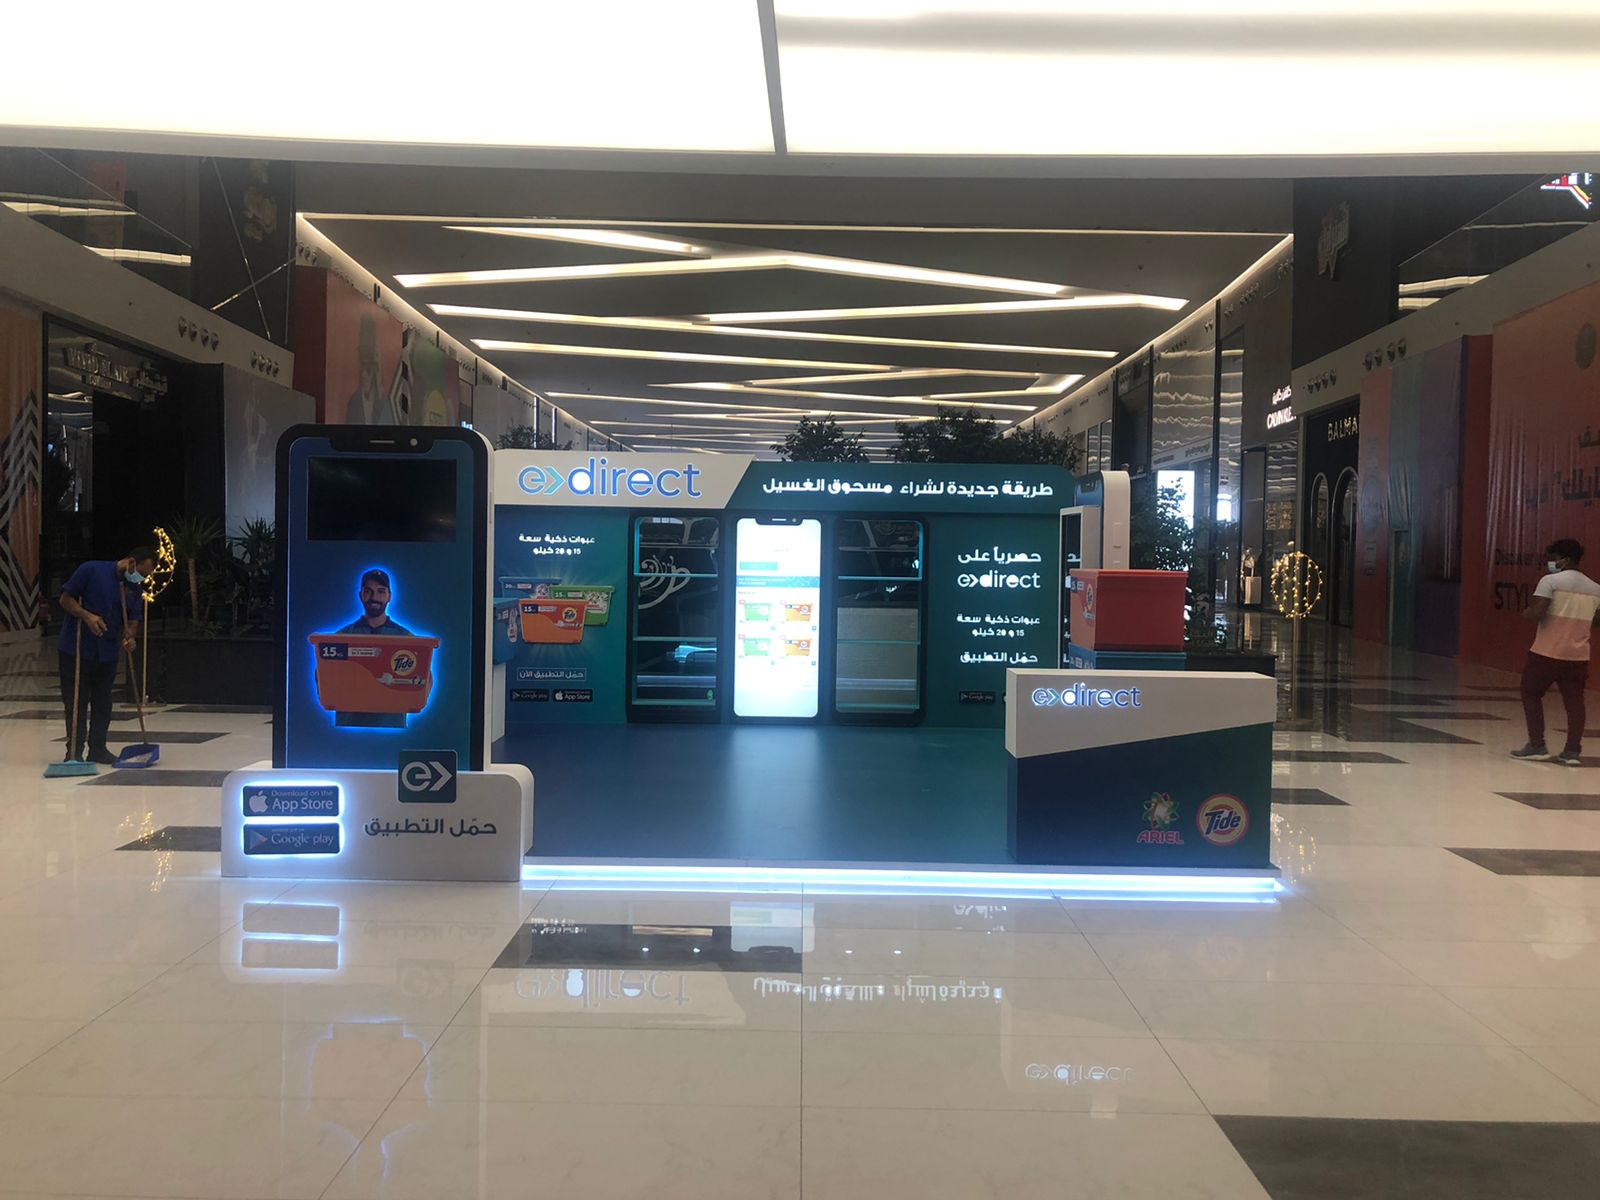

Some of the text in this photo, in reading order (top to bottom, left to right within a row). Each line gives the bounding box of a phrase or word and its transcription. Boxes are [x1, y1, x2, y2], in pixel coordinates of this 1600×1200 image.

[1328, 416, 1359, 442] BALMA
[762, 478, 1053, 497] طريقة جديدة لشراء مسحوق الغسيل
[518, 532, 541, 542] سعة
[568, 534, 596, 544] عبوات
[533, 546, 553, 555] كيلو
[555, 547, 565, 555] 20
[573, 547, 581, 555] 15
[957, 549, 990, 563] على
[956, 613, 1040, 625] عبوات ذكية سعة
[972, 628, 995, 637] كيلو
[996, 629, 1006, 637] 20
[1016, 629, 1025, 637] 15
[322, 646, 337, 657] 15
[960, 651, 1007, 664] التطبيق
[393, 657, 414, 671] Tide
[272, 797, 333, 813] App Store
[363, 817, 444, 837] التطبيق
[1204, 809, 1241, 836] Tide
[271, 832, 334, 848] Google play
[1136, 830, 1185, 845] ARIEL
